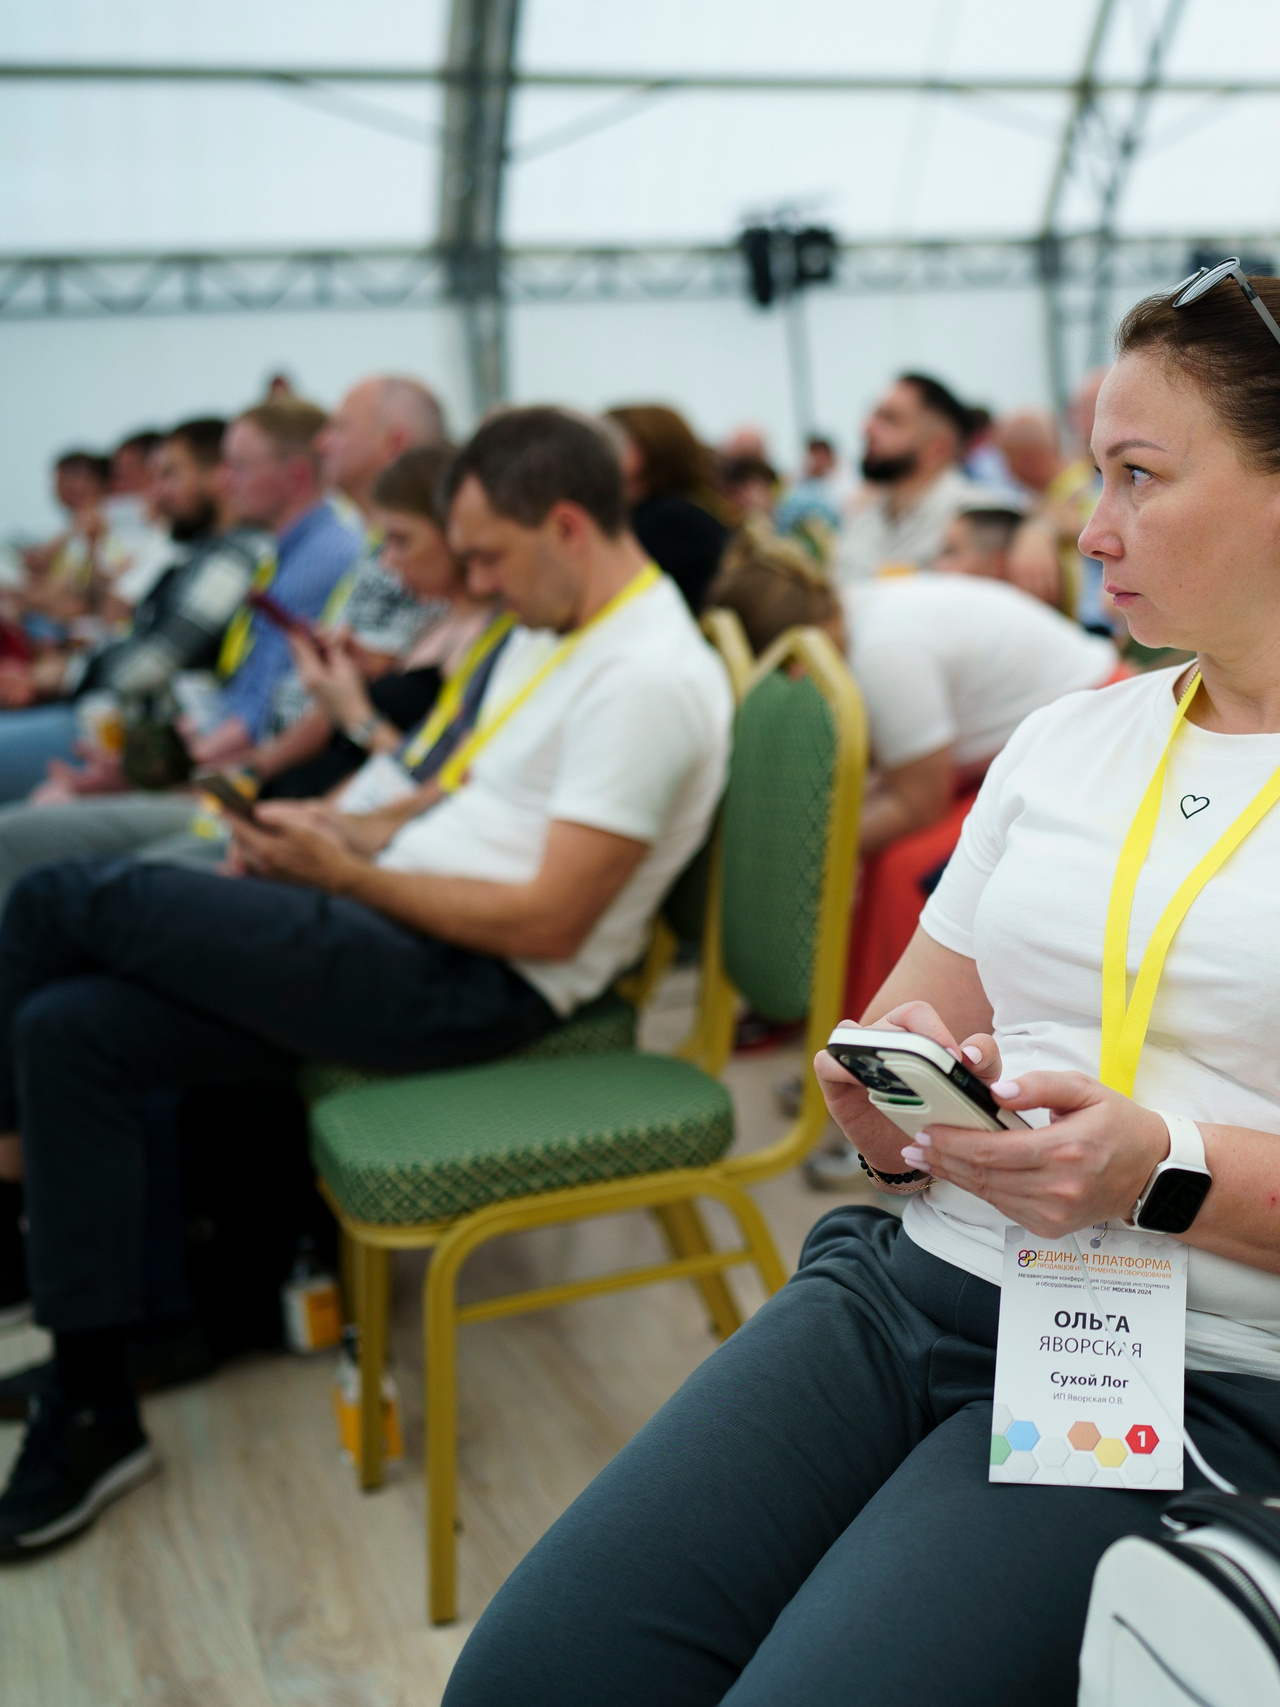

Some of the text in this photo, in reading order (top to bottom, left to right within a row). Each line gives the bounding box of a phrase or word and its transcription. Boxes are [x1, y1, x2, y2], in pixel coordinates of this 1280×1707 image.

[1092, 1254, 1172, 1271] ПЛАТФОРМА
[1018, 1272, 1059, 1280] Независимая
[1058, 1275, 1100, 1284] конфереция
[1037, 1263, 1074, 1271] ПРОДАВЦОВ
[1075, 1266, 1117, 1275] ИТРУМЕНТА
[1124, 1269, 1172, 1279] ОБОРУДОВАНИЯ
[1112, 1286, 1137, 1294] МОСКВА
[1136, 1288, 1152, 1296] 2024
[1050, 1371, 1130, 1389] Сухой Лог
[1053, 1392, 1125, 1405] ИП Яворская О.В.
[1137, 1430, 1146, 1448] 1
